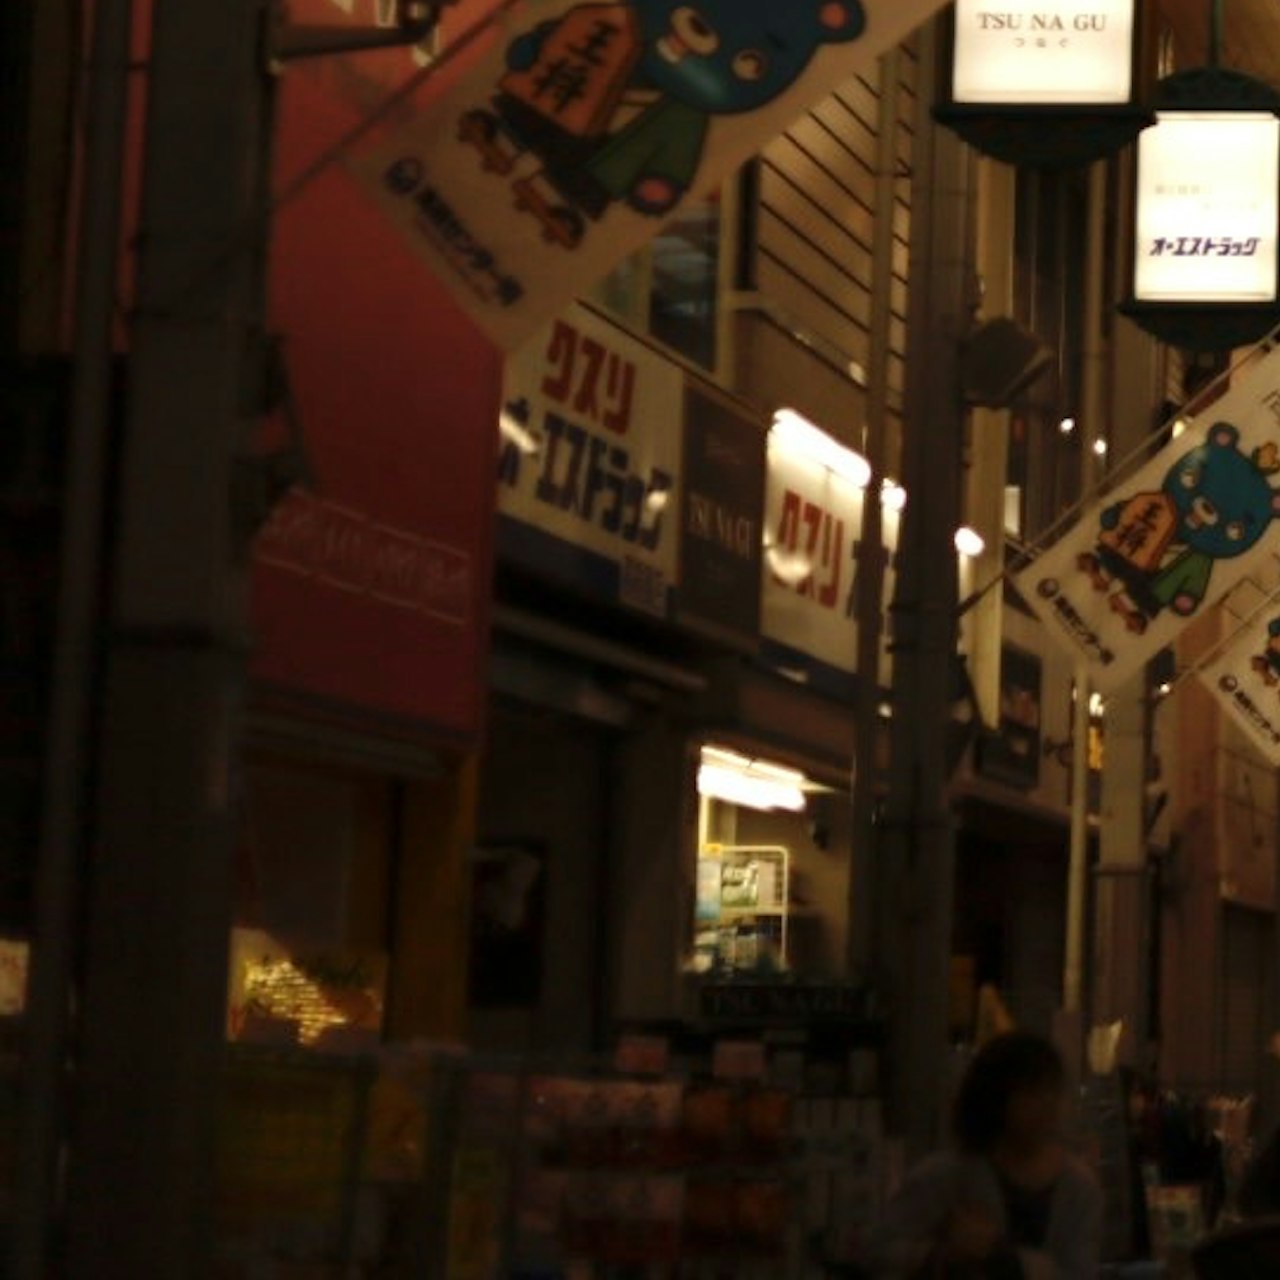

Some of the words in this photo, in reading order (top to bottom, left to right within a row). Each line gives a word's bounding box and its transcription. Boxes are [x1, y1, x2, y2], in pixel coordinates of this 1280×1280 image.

[976, 13, 1023, 30] TSU
[1030, 13, 1065, 30] NA
[1073, 13, 1108, 32] GU
[541, 319, 636, 435] クスリ
